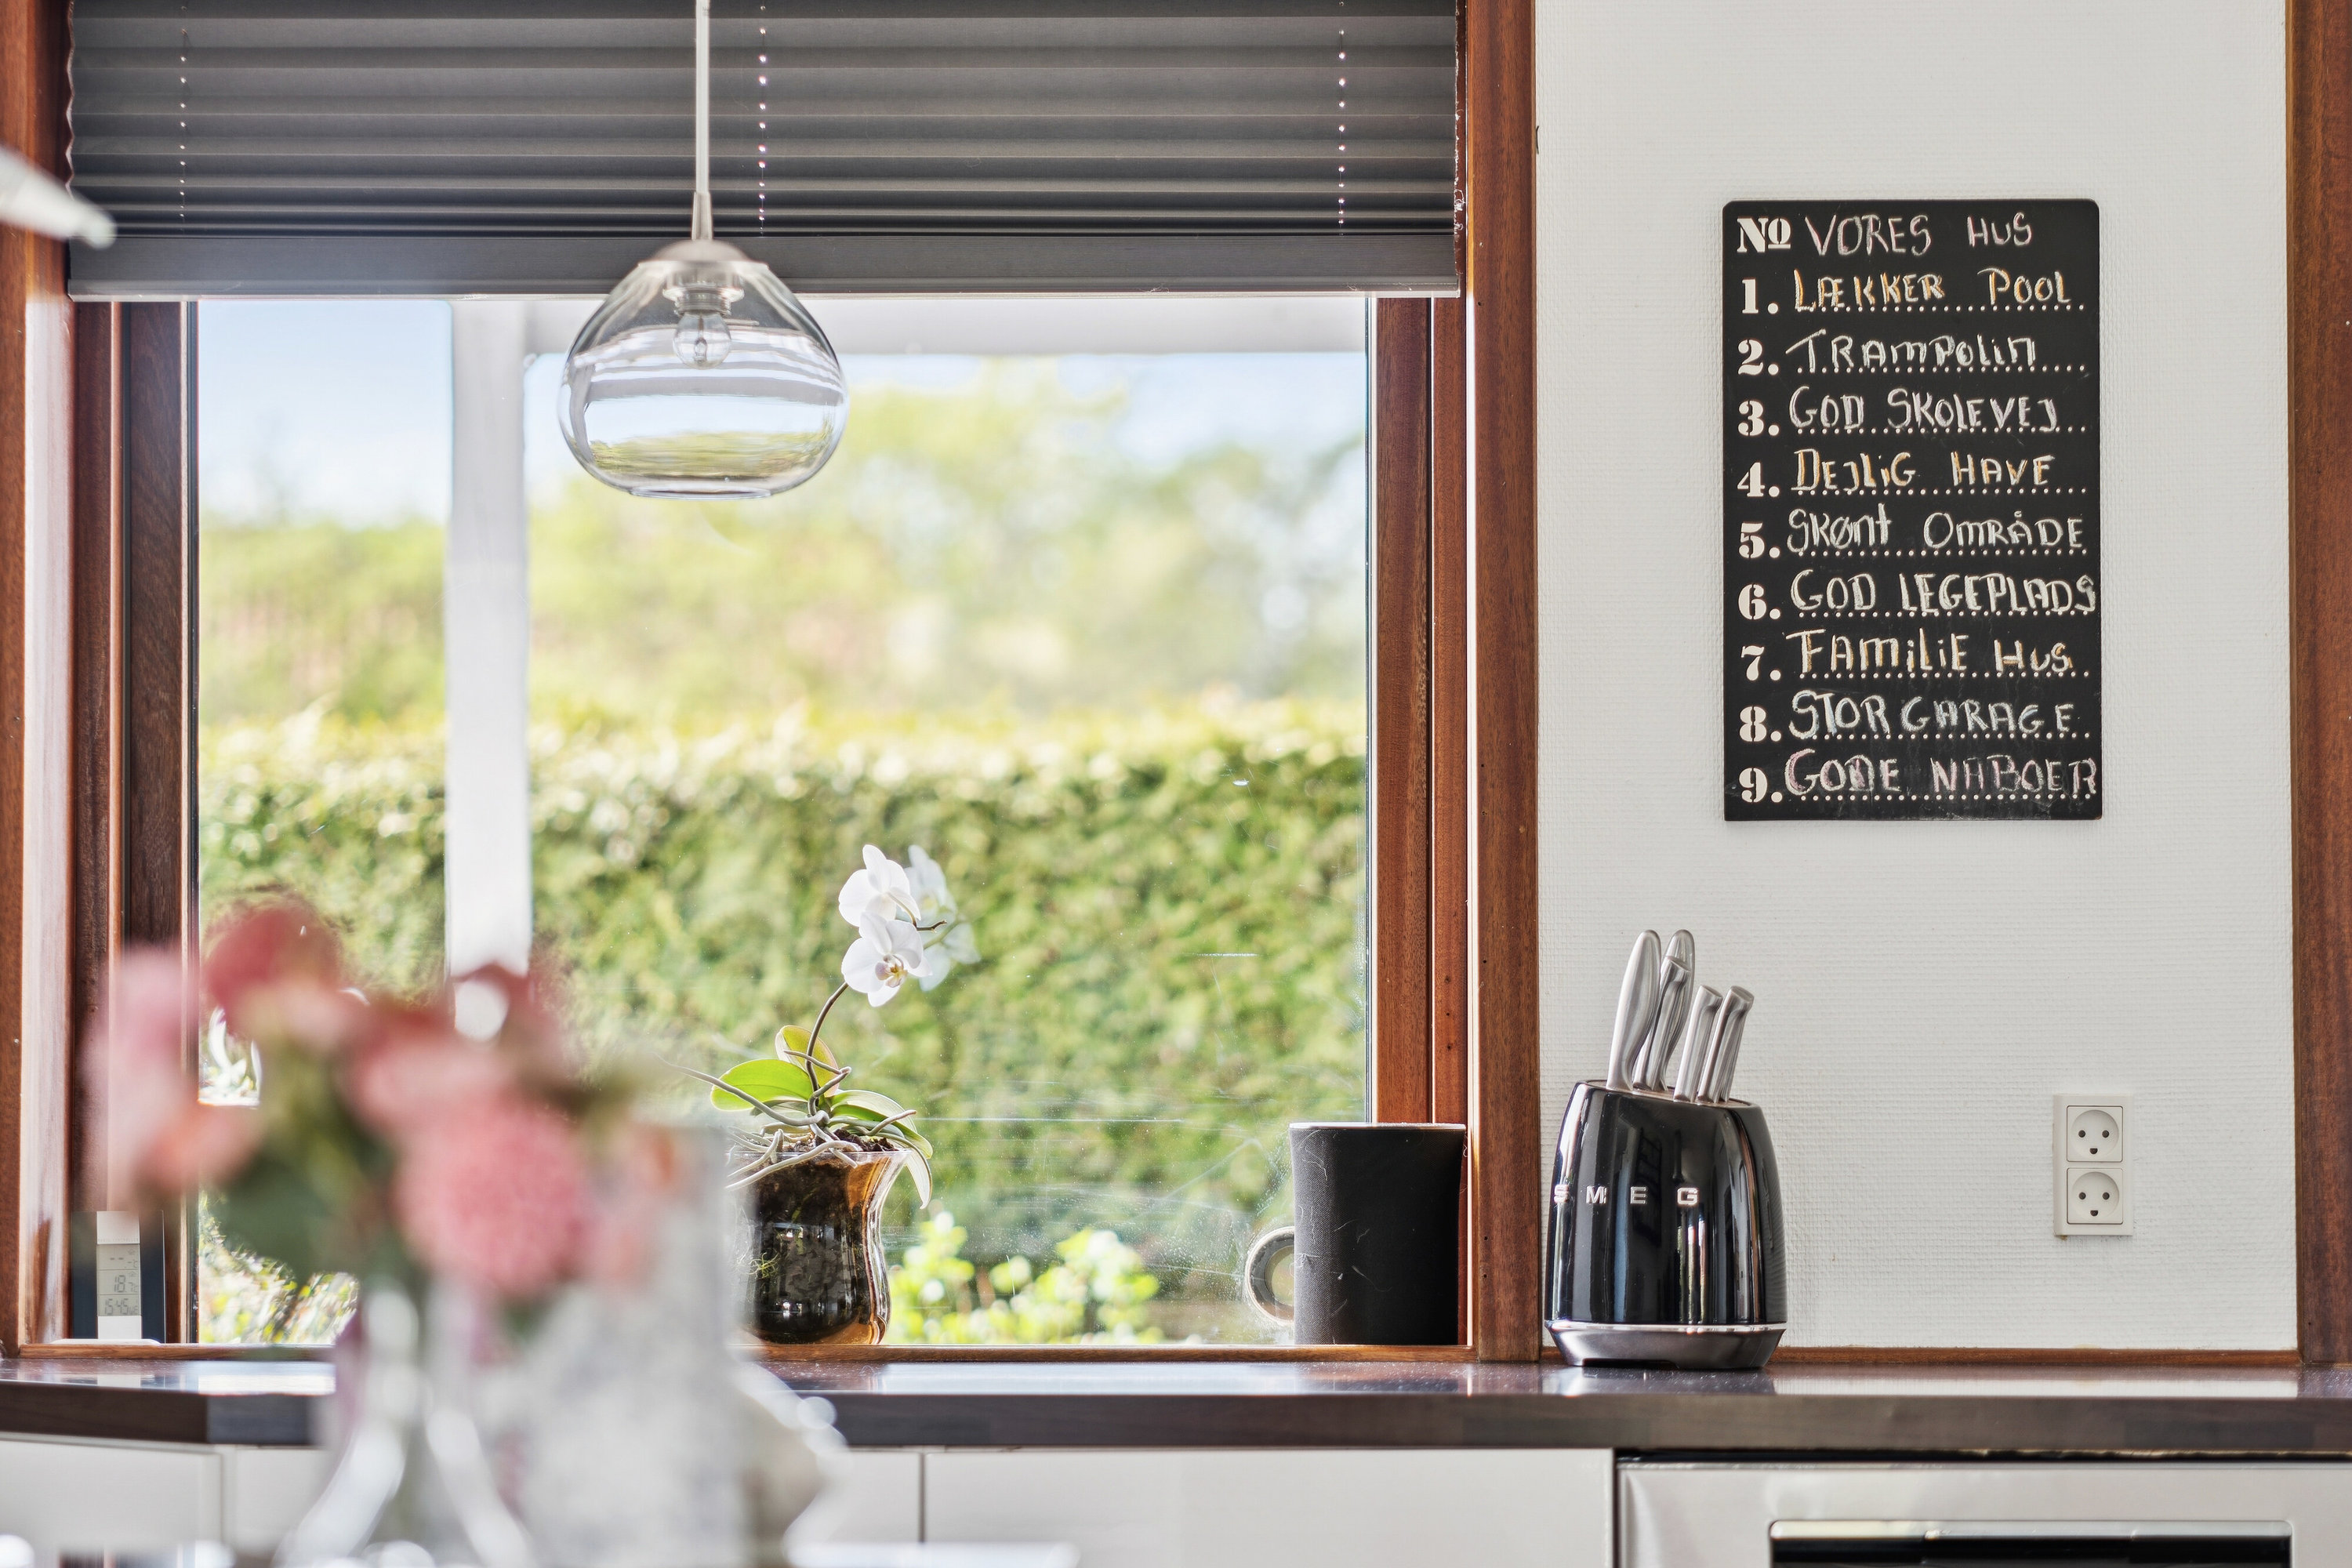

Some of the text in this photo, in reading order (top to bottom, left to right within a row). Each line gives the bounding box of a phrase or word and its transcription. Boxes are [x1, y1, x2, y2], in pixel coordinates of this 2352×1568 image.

[1806, 215, 1931, 256] VORES
[1968, 212, 2033, 247] HUS
[1741, 268, 2071, 314] 1. LÆKKER POOL
[1737, 339, 1779, 376] 2.
[1737, 387, 2056, 437] 3. GOD SKOLEVEJ
[1737, 462, 1780, 498] 4.
[1951, 452, 2055, 486] HAVE
[1738, 522, 1780, 559] 5.
[1737, 569, 2096, 620] 6. GOD LEGEPLADS
[1740, 644, 1781, 681] 7.
[1738, 690, 2074, 742] 8. STOR GARAGE
[1738, 748, 2098, 804] 9. GODE NABOER
[1554, 1183, 1700, 1206] SMEG
